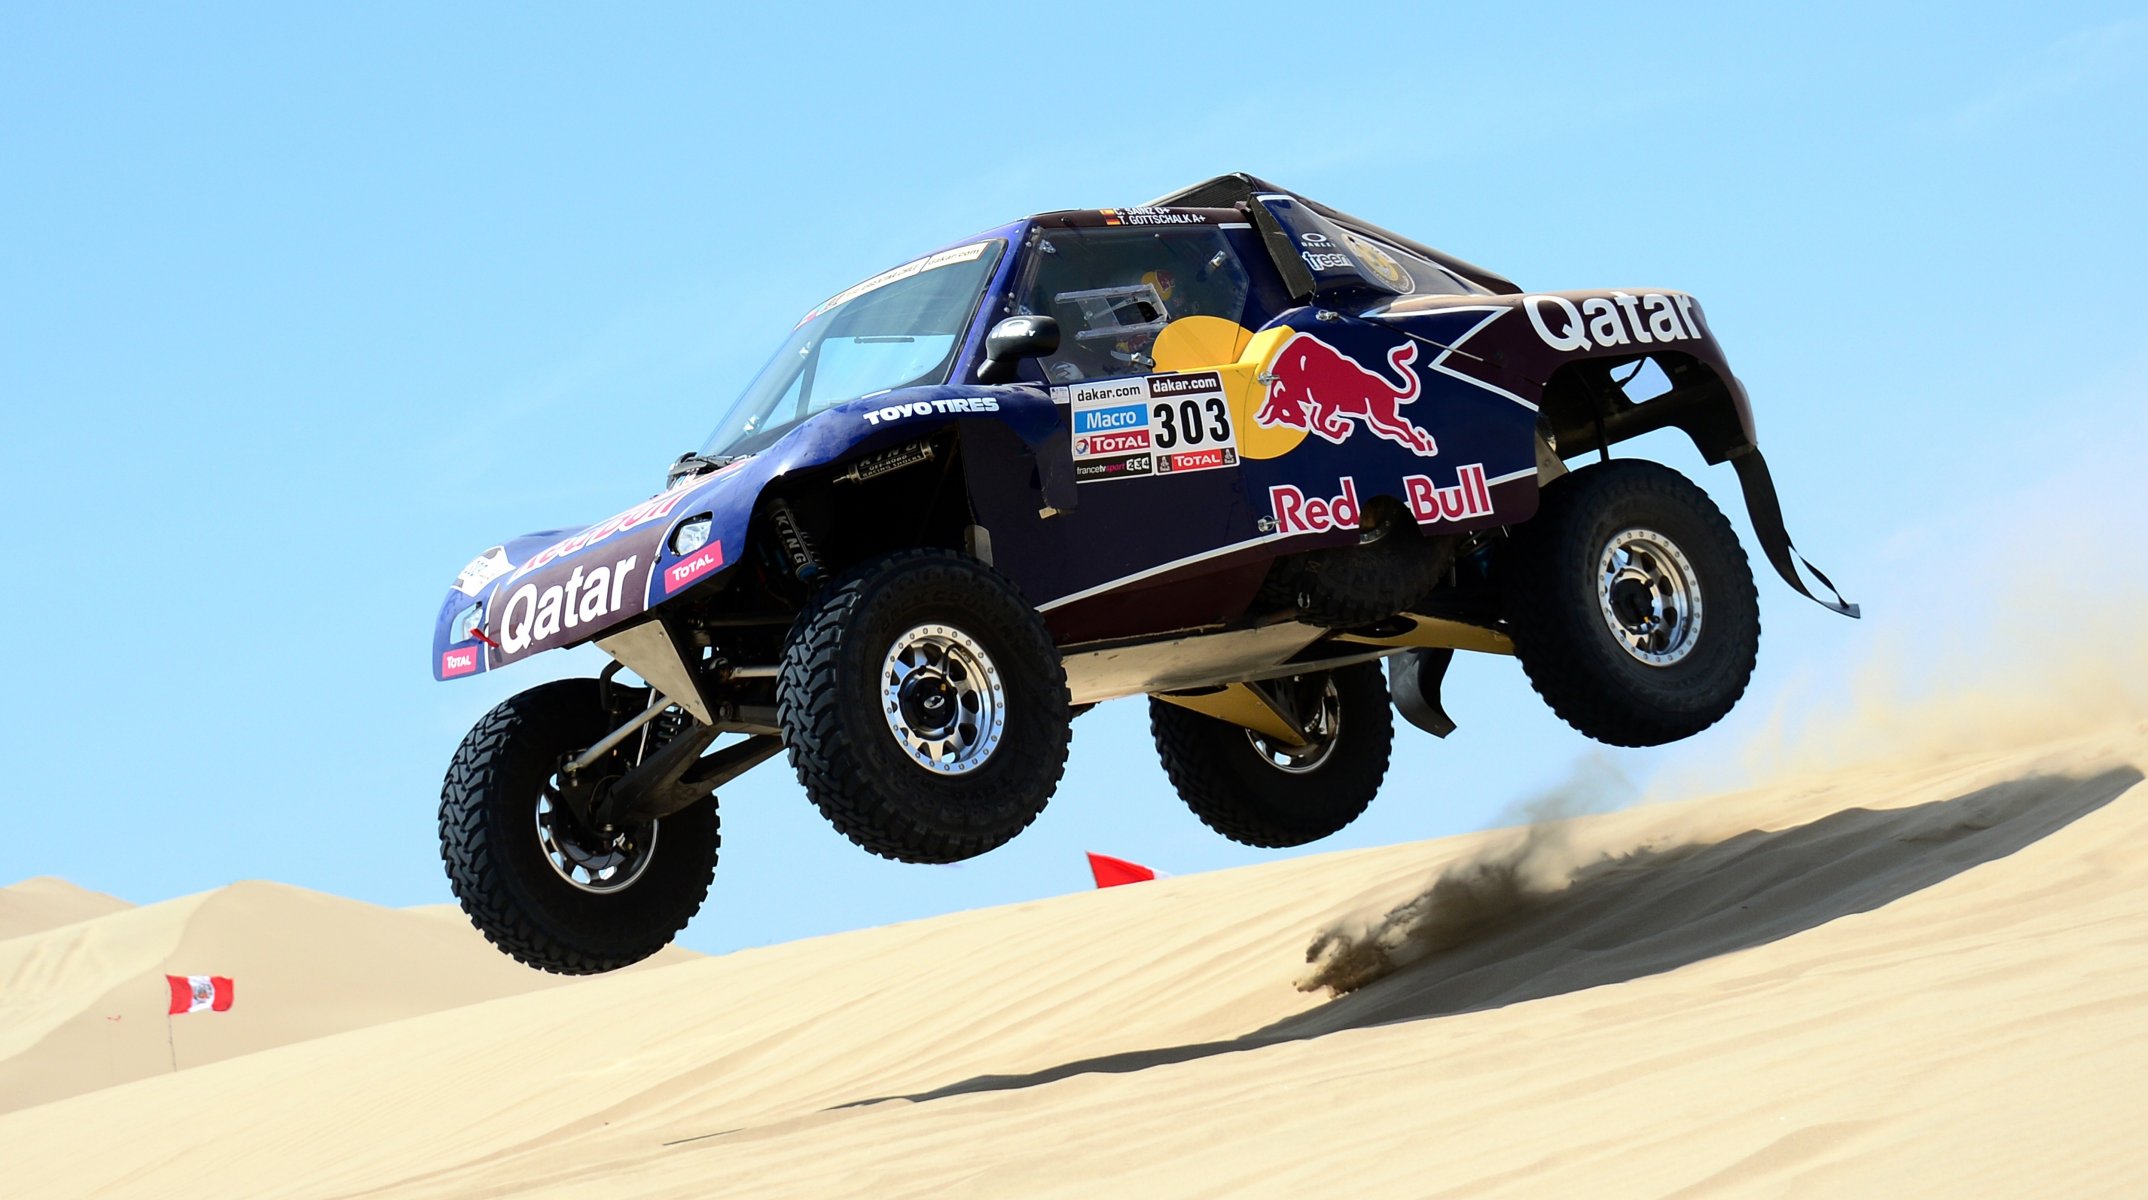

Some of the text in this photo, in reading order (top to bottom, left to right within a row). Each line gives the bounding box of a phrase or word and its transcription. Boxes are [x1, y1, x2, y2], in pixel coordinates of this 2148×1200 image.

[1117, 213, 1207, 225] T. GOTTSCHALK A+
[1523, 291, 1702, 352] Qatar
[1077, 385, 1141, 402] dakar.com
[1152, 377, 1217, 393] dakar.com
[863, 397, 1000, 426] TOYO TIRES
[1086, 411, 1137, 430] Macro
[1153, 397, 1231, 449] 303
[1091, 434, 1149, 451] TOTAL
[1173, 452, 1221, 468] TOTAL
[1269, 463, 1495, 535] Red Bull
[775, 514, 807, 564] KING
[671, 553, 715, 582] TOTAL
[500, 555, 638, 654] Qatar
[446, 655, 472, 670] TOTAL
